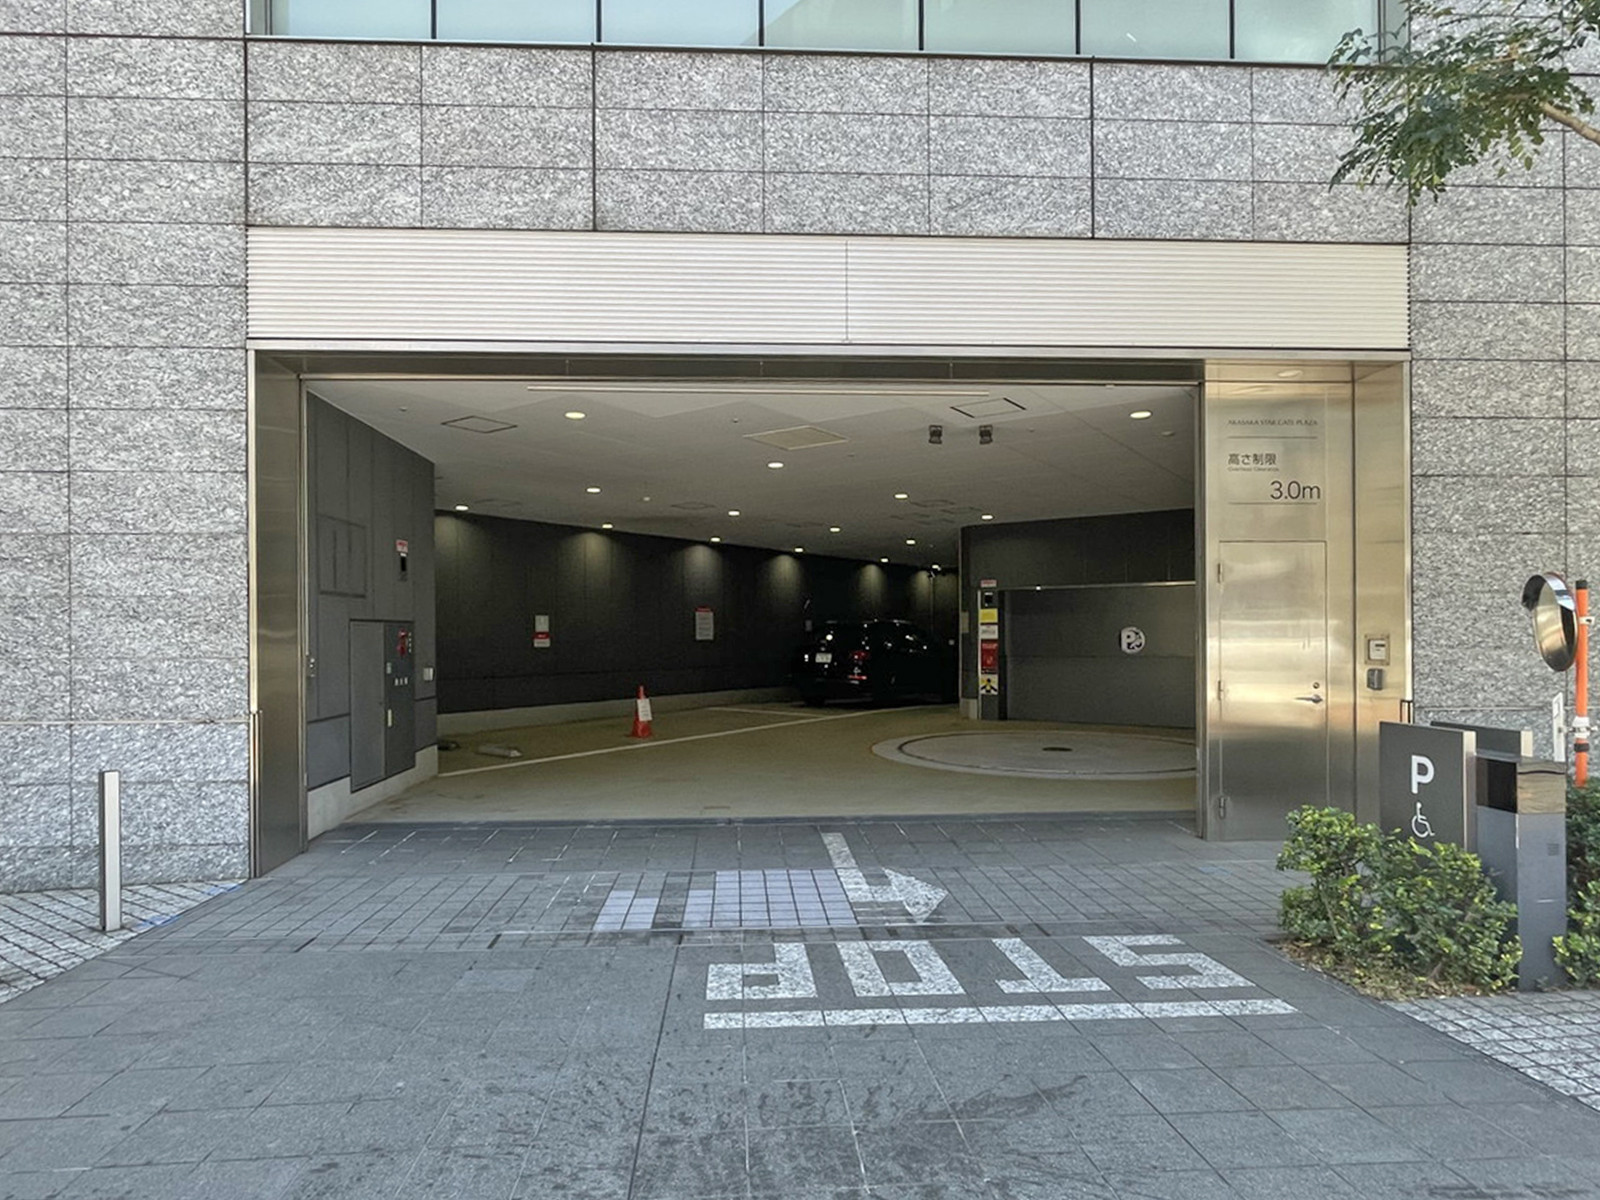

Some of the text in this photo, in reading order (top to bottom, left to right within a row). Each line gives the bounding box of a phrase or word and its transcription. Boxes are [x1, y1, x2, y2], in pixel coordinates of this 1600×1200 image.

[1296, 418, 1318, 427] PLAZA
[1228, 453, 1277, 466] 高さ制限
[1270, 480, 1321, 500] 3.0m
[1411, 754, 1435, 794] P
[705, 934, 1256, 1000] STOP
